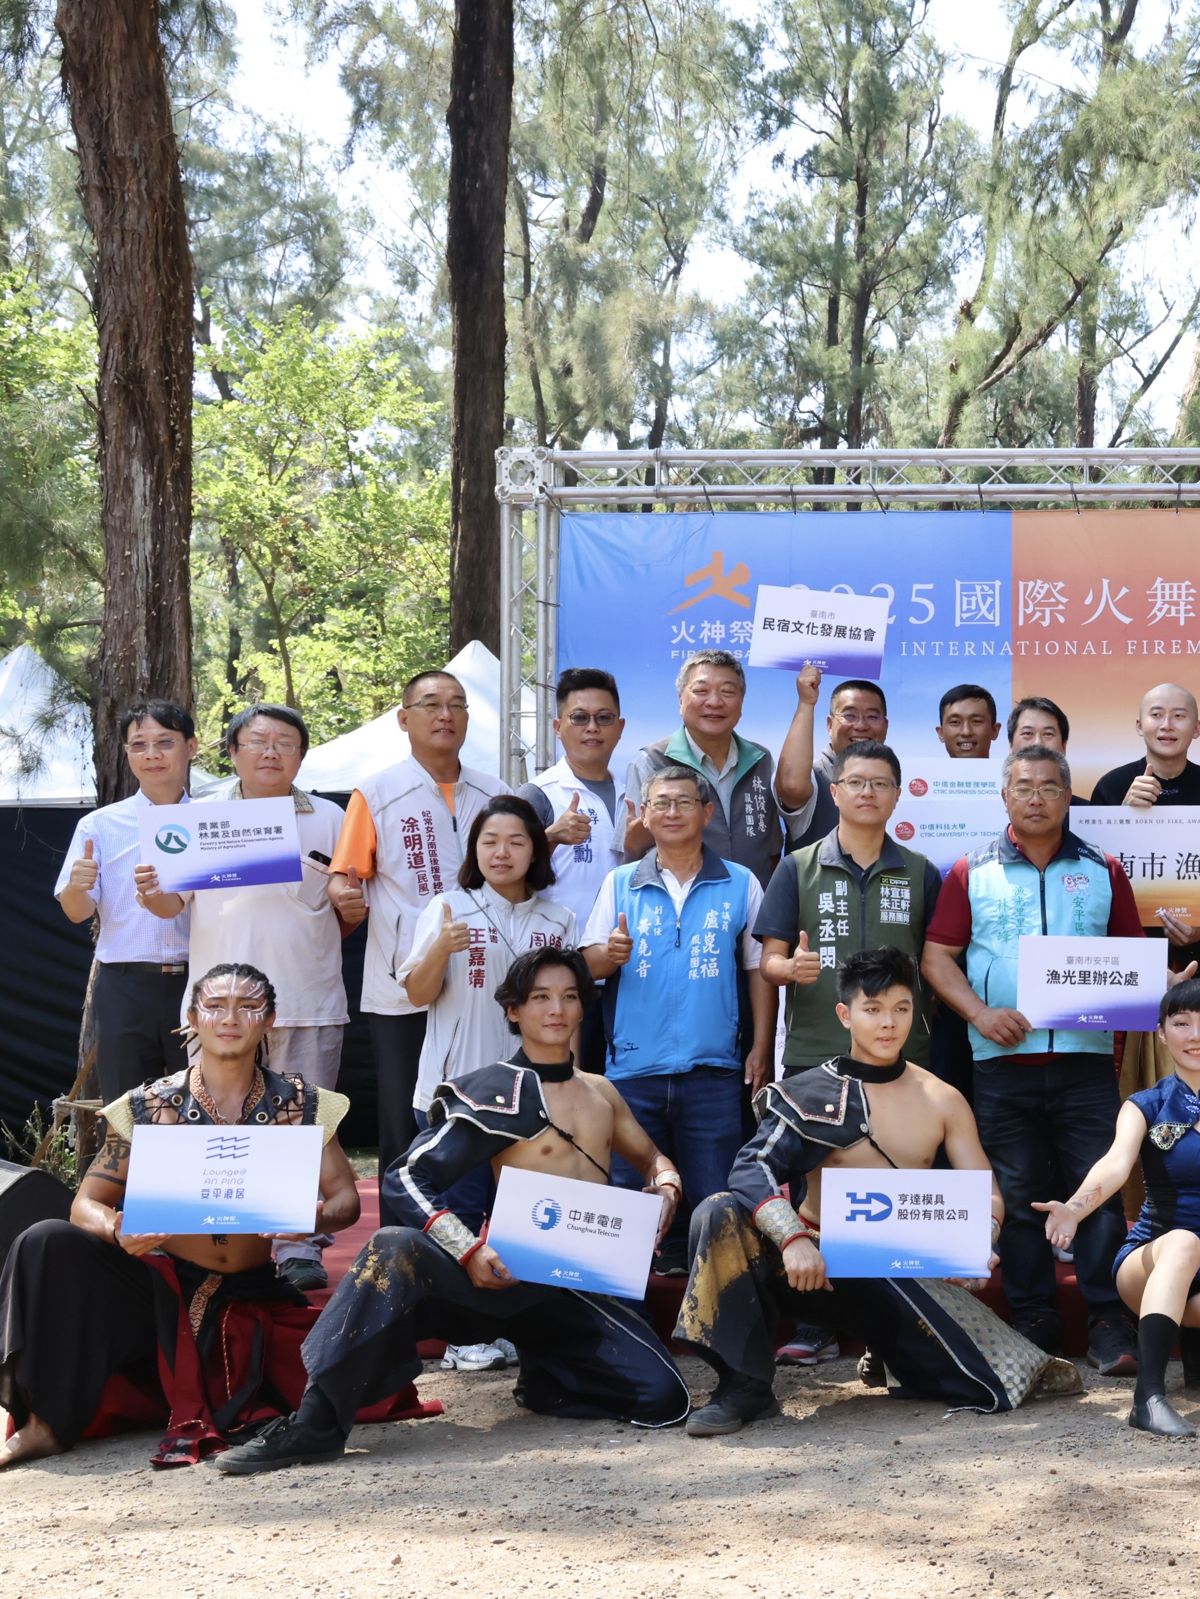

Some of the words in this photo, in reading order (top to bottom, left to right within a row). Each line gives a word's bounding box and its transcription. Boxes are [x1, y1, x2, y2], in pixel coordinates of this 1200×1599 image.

[810, 609, 836, 620] 臺南市
[671, 621, 754, 645] 火神祭
[762, 616, 876, 643] 民宿文化發展協會
[901, 639, 1113, 657] INTERNATIONAL
[198, 820, 230, 831] 農業部
[199, 826, 283, 841] 林業及自然保育署
[835, 880, 849, 936] 副主任
[1065, 955, 1120, 966] 臺南市安平區
[1046, 969, 1139, 987] 漁光里辦公處
[897, 1193, 945, 1206] 亨達模具
[568, 1209, 623, 1231] 中華電信
[897, 1209, 969, 1221] 股份有限公司
[566, 1223, 597, 1235] Chunghwa
[597, 1228, 620, 1239] Telecom
